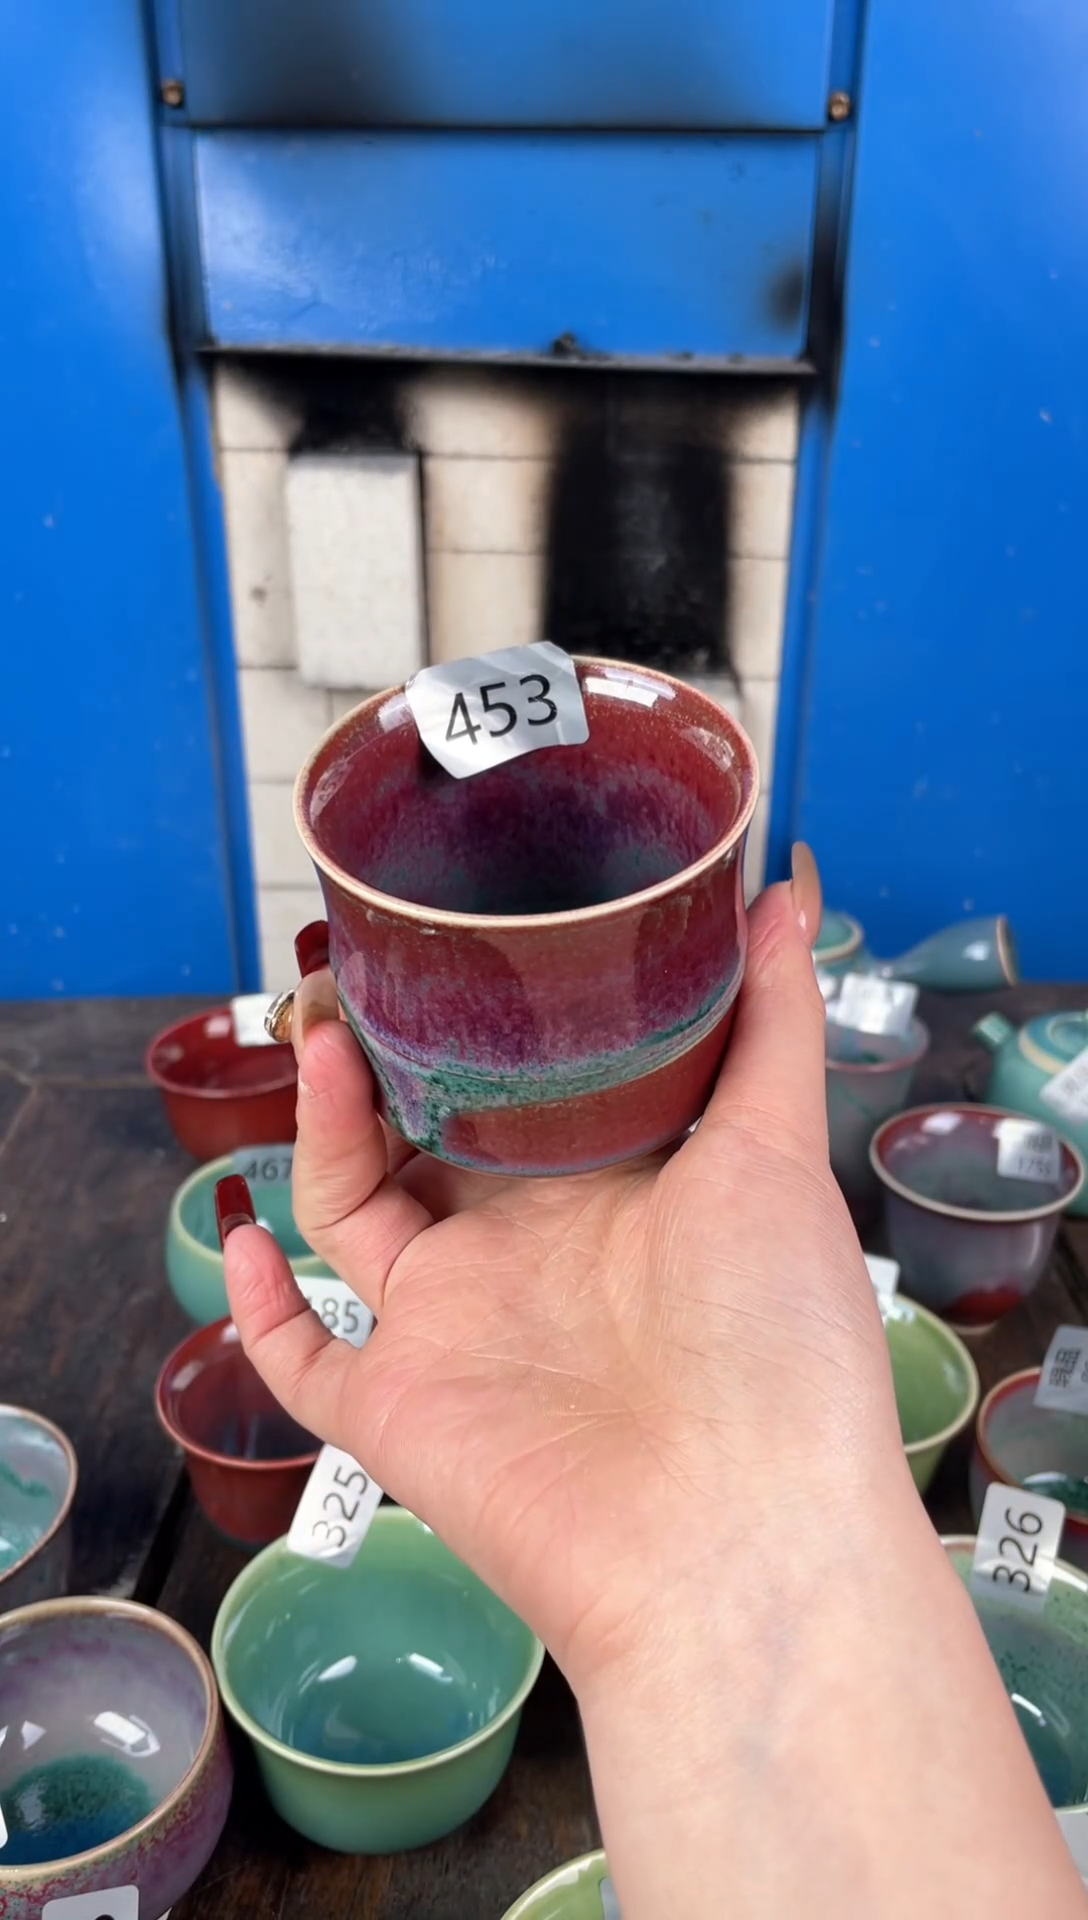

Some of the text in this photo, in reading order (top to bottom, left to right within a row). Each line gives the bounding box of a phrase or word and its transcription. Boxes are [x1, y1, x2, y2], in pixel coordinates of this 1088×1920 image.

[446, 674, 557, 745] 453
[306, 1296, 360, 1334] 85
[312, 1465, 368, 1548] 325
[992, 1507, 1042, 1592] 326
